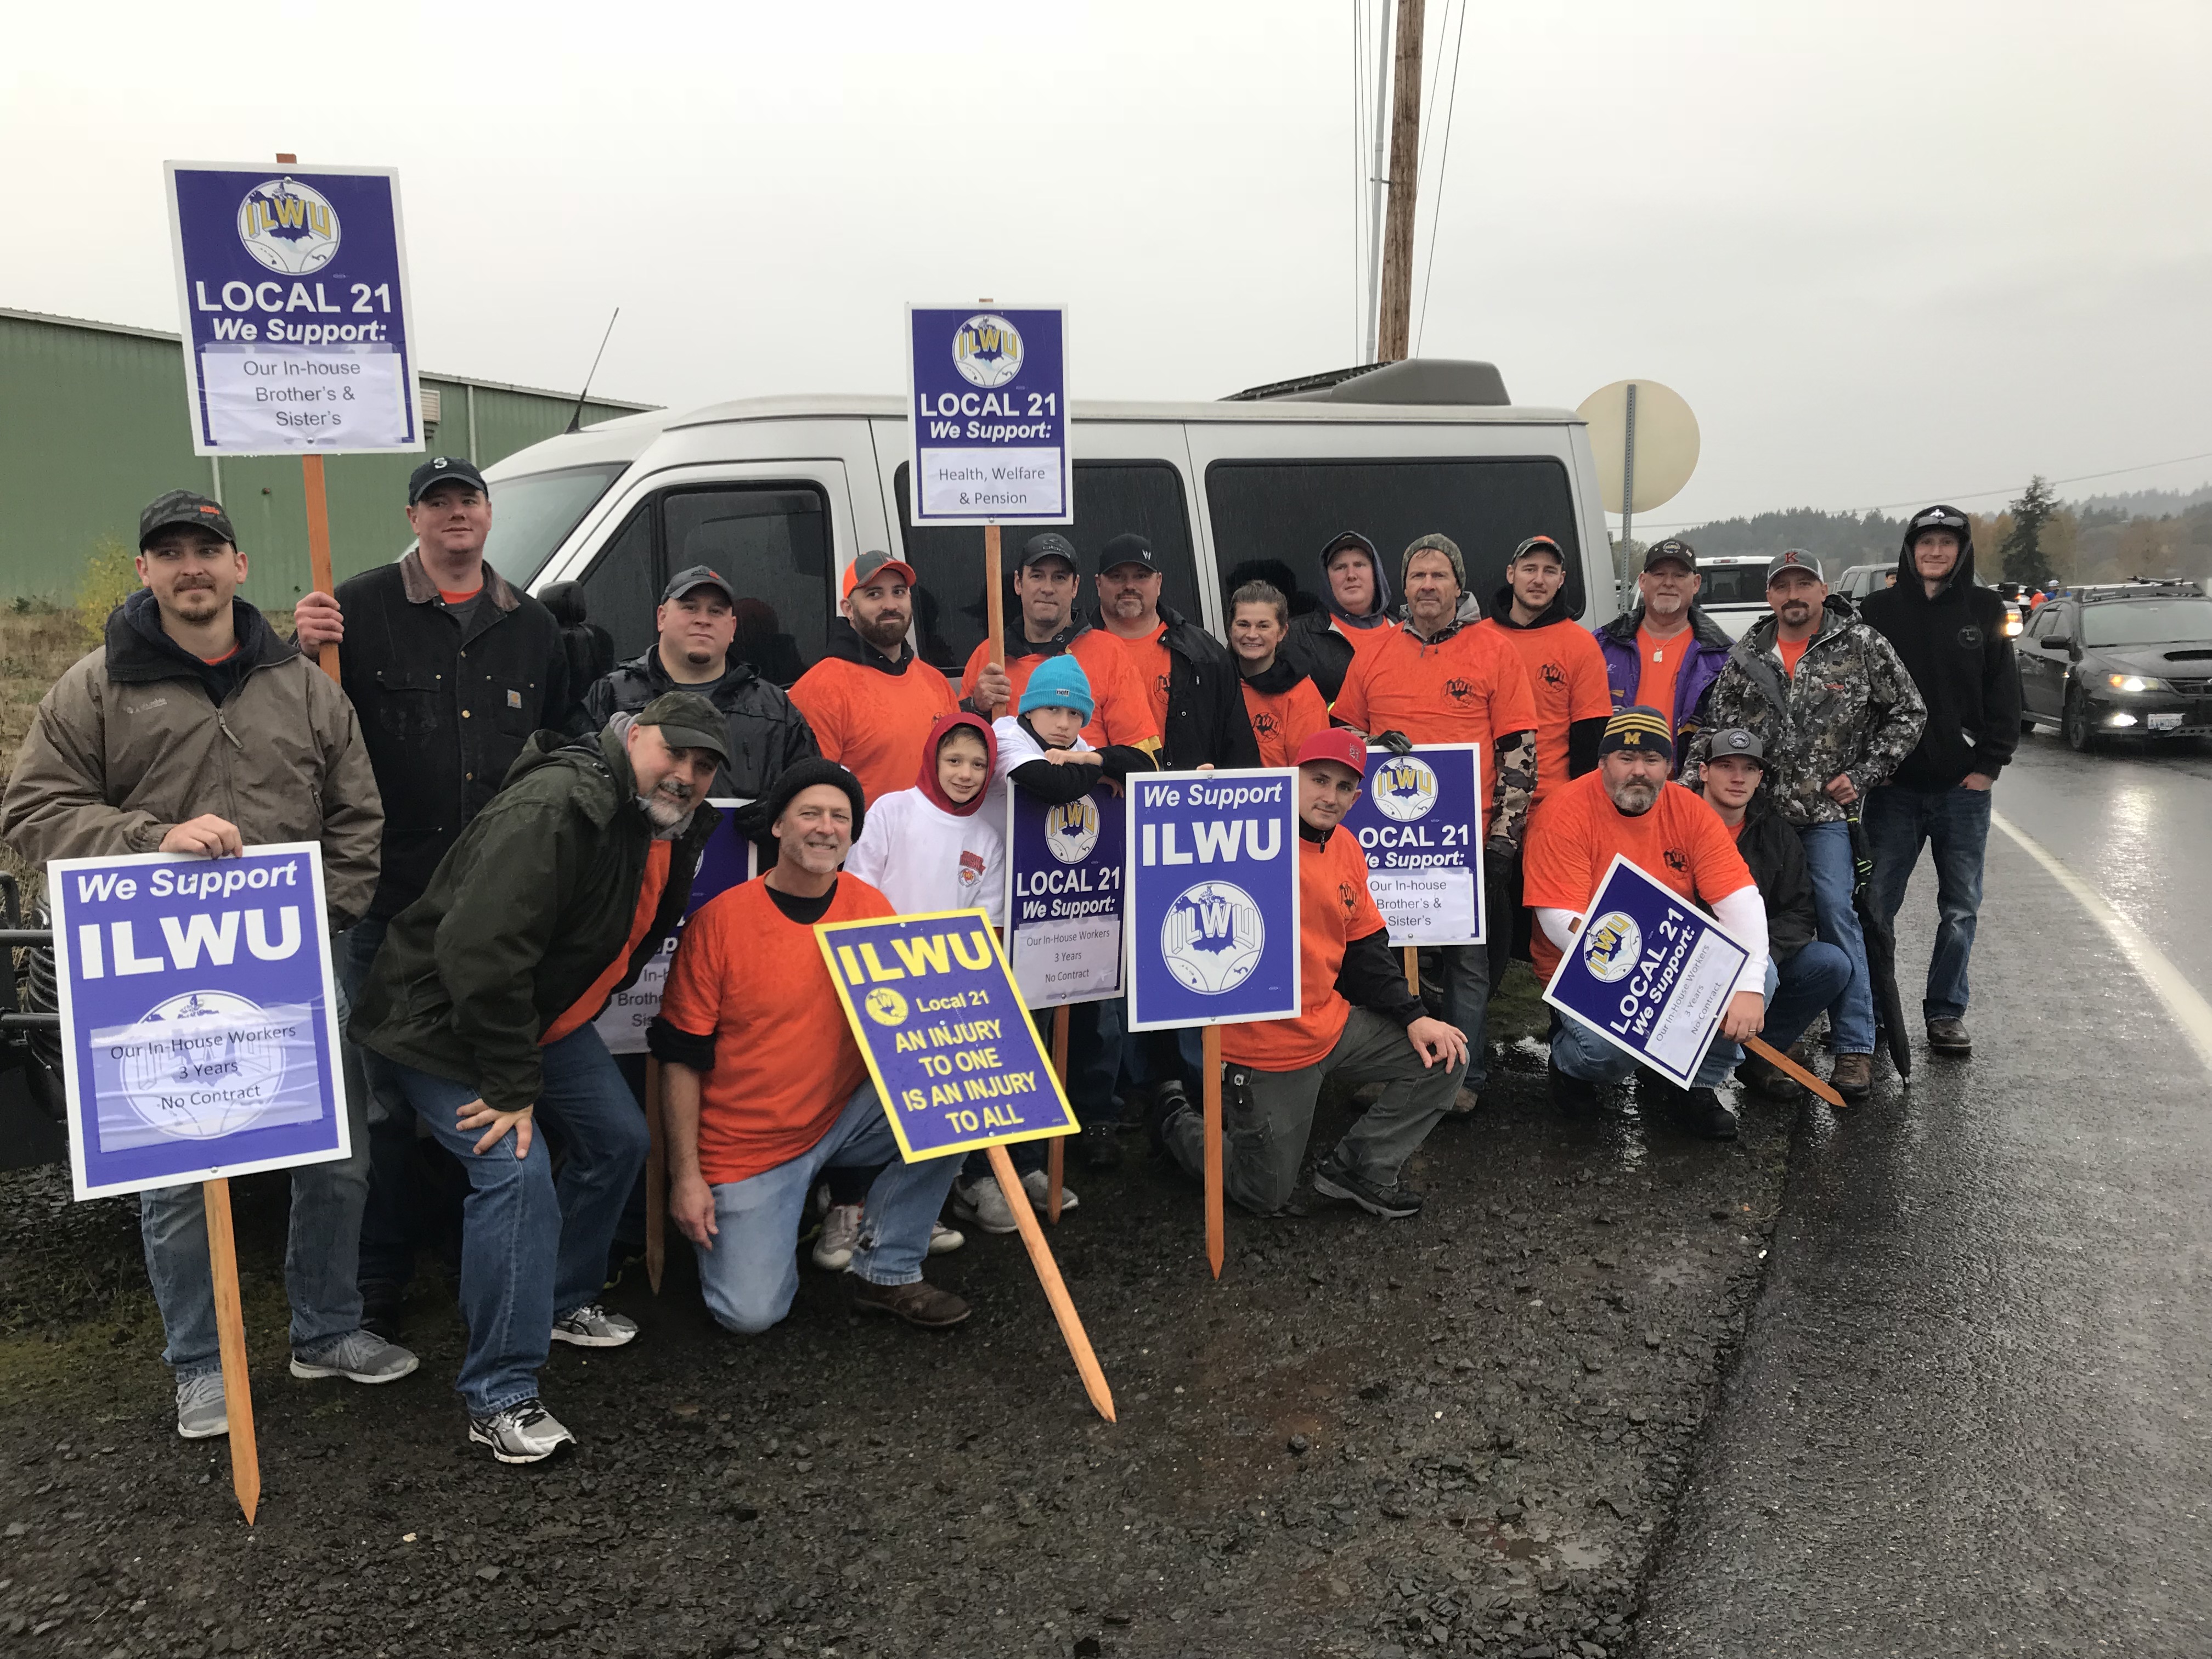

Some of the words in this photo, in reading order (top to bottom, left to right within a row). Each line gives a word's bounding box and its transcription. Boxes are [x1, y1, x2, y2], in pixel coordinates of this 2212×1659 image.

[246, 199, 331, 240] ILWU
[196, 281, 341, 313] LOCAL
[351, 283, 392, 313] 21
[212, 318, 258, 341] We
[267, 319, 387, 346] Support:
[959, 328, 1017, 360] ILWU
[244, 360, 278, 376] Our
[284, 360, 361, 375] In-house
[256, 386, 337, 402] Brother's
[343, 386, 356, 400] &
[921, 393, 1020, 417] LOCAL
[1028, 393, 1056, 416] 21
[276, 411, 342, 426] Sister's
[930, 421, 961, 439] We
[967, 421, 1052, 442] Support:
[939, 468, 988, 482] Health,
[992, 467, 1045, 480] Welfare
[959, 493, 970, 504] &
[975, 492, 1027, 505] Pension
[1624, 732, 1641, 744] M
[1144, 786, 1181, 808] We
[1188, 782, 1283, 810] Support
[1378, 769, 1432, 798] ILWU
[1051, 803, 1096, 837] ILWU
[1143, 819, 1282, 866] ILWU
[1358, 826, 1435, 849] OCAL
[1442, 825, 1469, 845] 21
[1385, 851, 1465, 870] Support:
[78, 873, 137, 903] We
[150, 860, 297, 900] Support
[1017, 868, 1093, 897] LOCAL
[1098, 866, 1120, 890] 21
[1370, 881, 1392, 891] Our
[1396, 880, 1447, 891] In-house
[1023, 900, 1047, 919] We
[1051, 896, 1115, 919] Support:
[1377, 898, 1430, 910] Brother's
[1432, 899, 1442, 909] &
[1171, 902, 1255, 955] ILWU
[1388, 916, 1431, 927] Sister's
[79, 906, 302, 979] ILWU
[1027, 936, 1042, 947] Our
[1043, 934, 1077, 945] In-House
[1079, 930, 1110, 940] Workers
[1589, 915, 1632, 975] ILWU
[837, 931, 993, 985] ILWU
[1054, 953, 1059, 962] 3
[1061, 952, 1082, 962] Years
[1610, 946, 1668, 1035] LOCAL
[1659, 907, 1684, 942] 21
[1045, 973, 1056, 984] No
[1057, 968, 1090, 982] Contract
[1632, 1006, 1654, 1036] We
[1649, 925, 1695, 1003] Support:
[916, 994, 966, 1013] Local
[968, 989, 991, 1006] 21
[1656, 1025, 1669, 1042] Our
[1665, 984, 1689, 1024] In-House
[1685, 944, 1709, 982] Workers
[1688, 984, 1704, 1009] Years
[1691, 1022, 1701, 1035] No
[1698, 981, 1722, 1022] Contract
[111, 1046, 145, 1060] Our
[149, 1035, 223, 1054] In-House
[228, 1026, 296, 1043] Workers
[895, 1029, 927, 1053] AN
[929, 1019, 1003, 1048] INJURY
[179, 1066, 188, 1079] 3
[194, 1061, 238, 1076] Years
[919, 1055, 953, 1077] TO
[955, 1047, 1003, 1072] ONE
[161, 1096, 185, 1110] No
[190, 1085, 261, 1105] Contract
[902, 1091, 927, 1112] IS
[932, 1081, 964, 1107] AN
[963, 1071, 1037, 1101] INJURY
[945, 1110, 979, 1134] TO
[983, 1103, 1025, 1129] ALL
